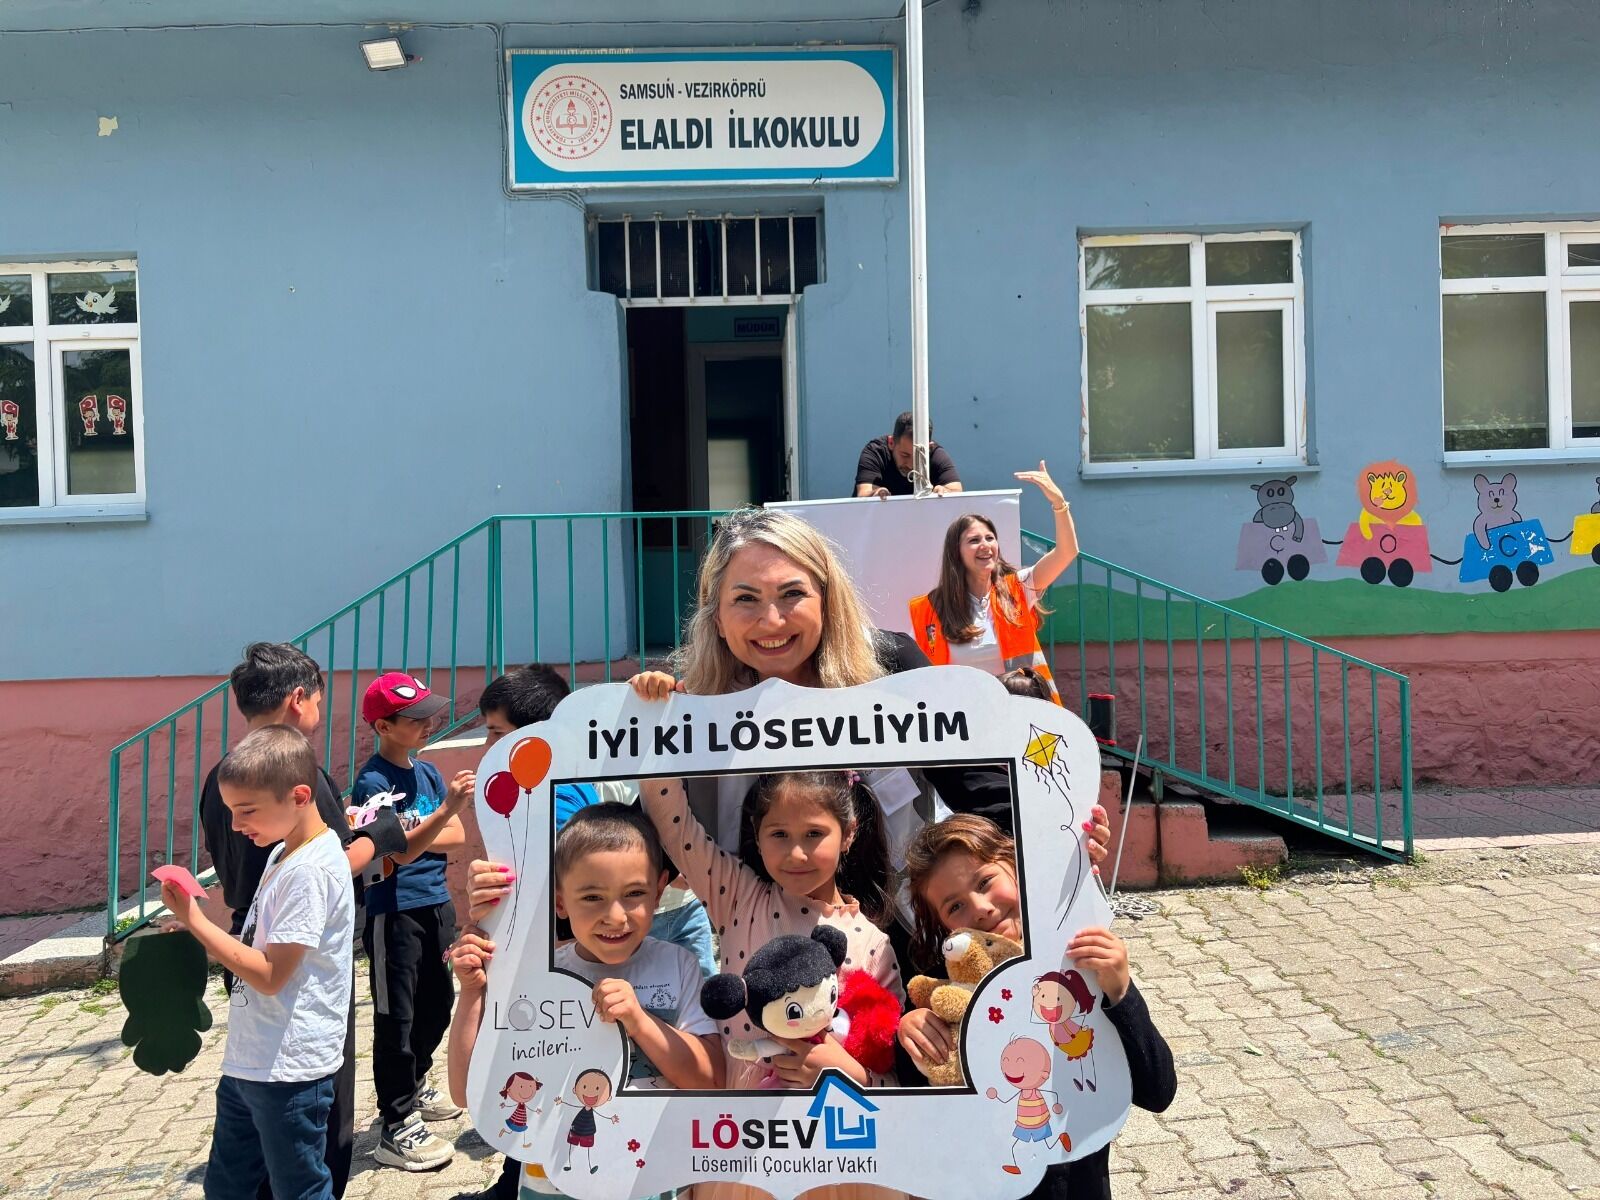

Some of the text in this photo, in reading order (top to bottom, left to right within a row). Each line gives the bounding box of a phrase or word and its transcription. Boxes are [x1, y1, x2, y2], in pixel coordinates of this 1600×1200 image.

[620, 108, 860, 150] ELALDI İLKOKULU
[588, 701, 970, 760] İYİ Kİ LÖSEVLİYİM
[494, 994, 597, 1032] LÖSEV
[511, 1037, 582, 1062] incileri...
[691, 1113, 819, 1150] LÖSEV
[692, 1155, 877, 1177] Lösemili Çocuklar Vakfı
